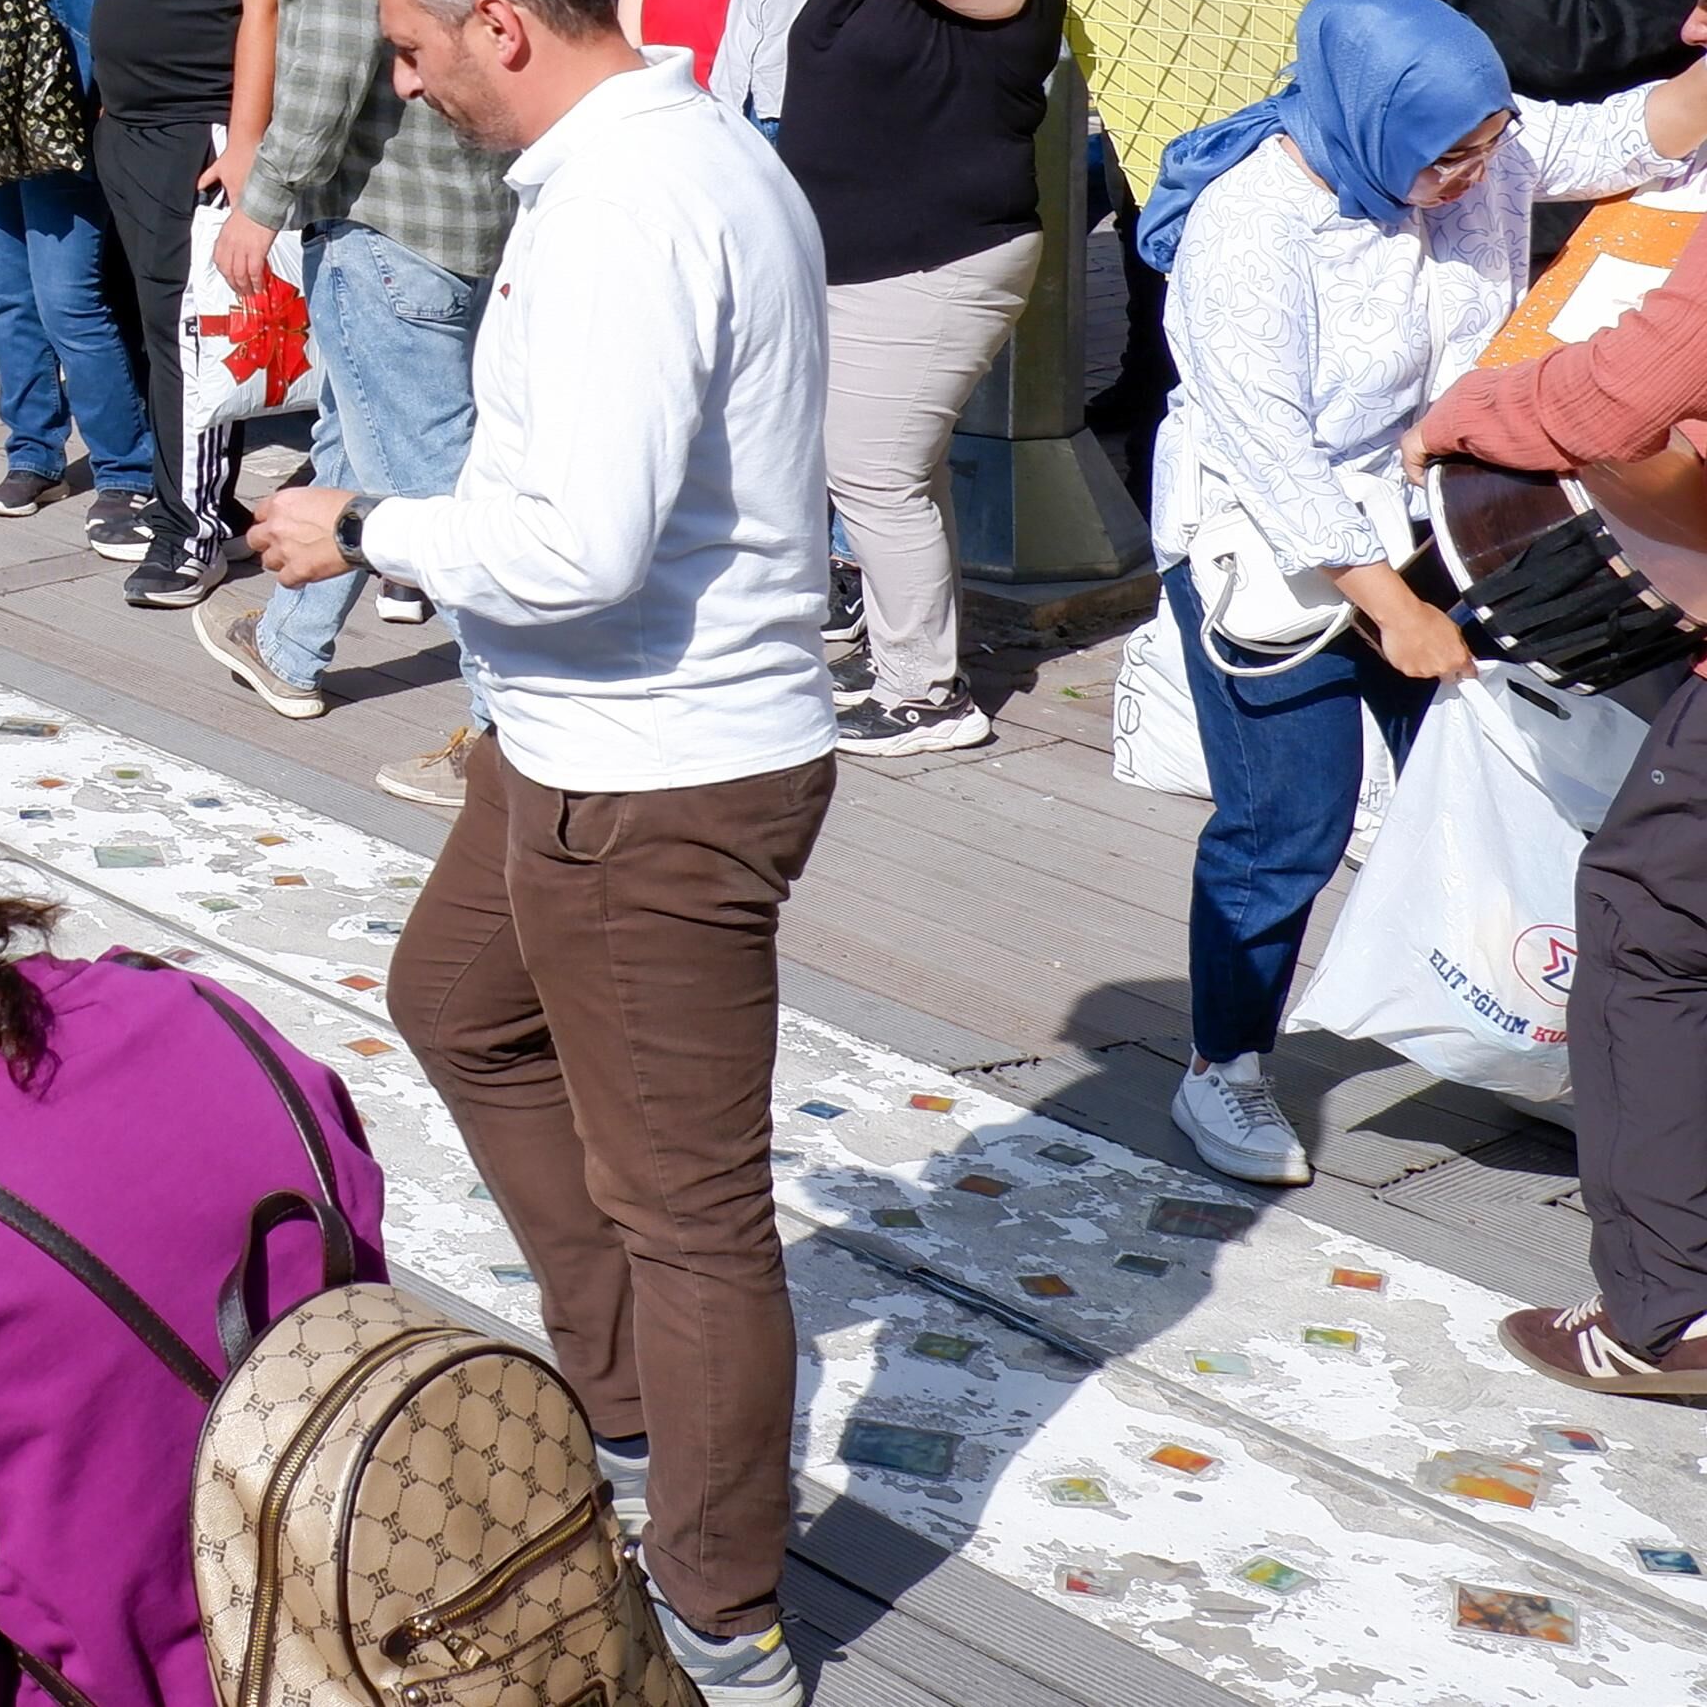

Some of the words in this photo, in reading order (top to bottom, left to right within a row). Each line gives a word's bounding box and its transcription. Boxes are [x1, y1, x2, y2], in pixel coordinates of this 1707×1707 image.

[1429, 948, 1468, 990] ELİT
[1463, 984, 1530, 1035] EĞİTİM
[1531, 1026, 1567, 1043] KU
